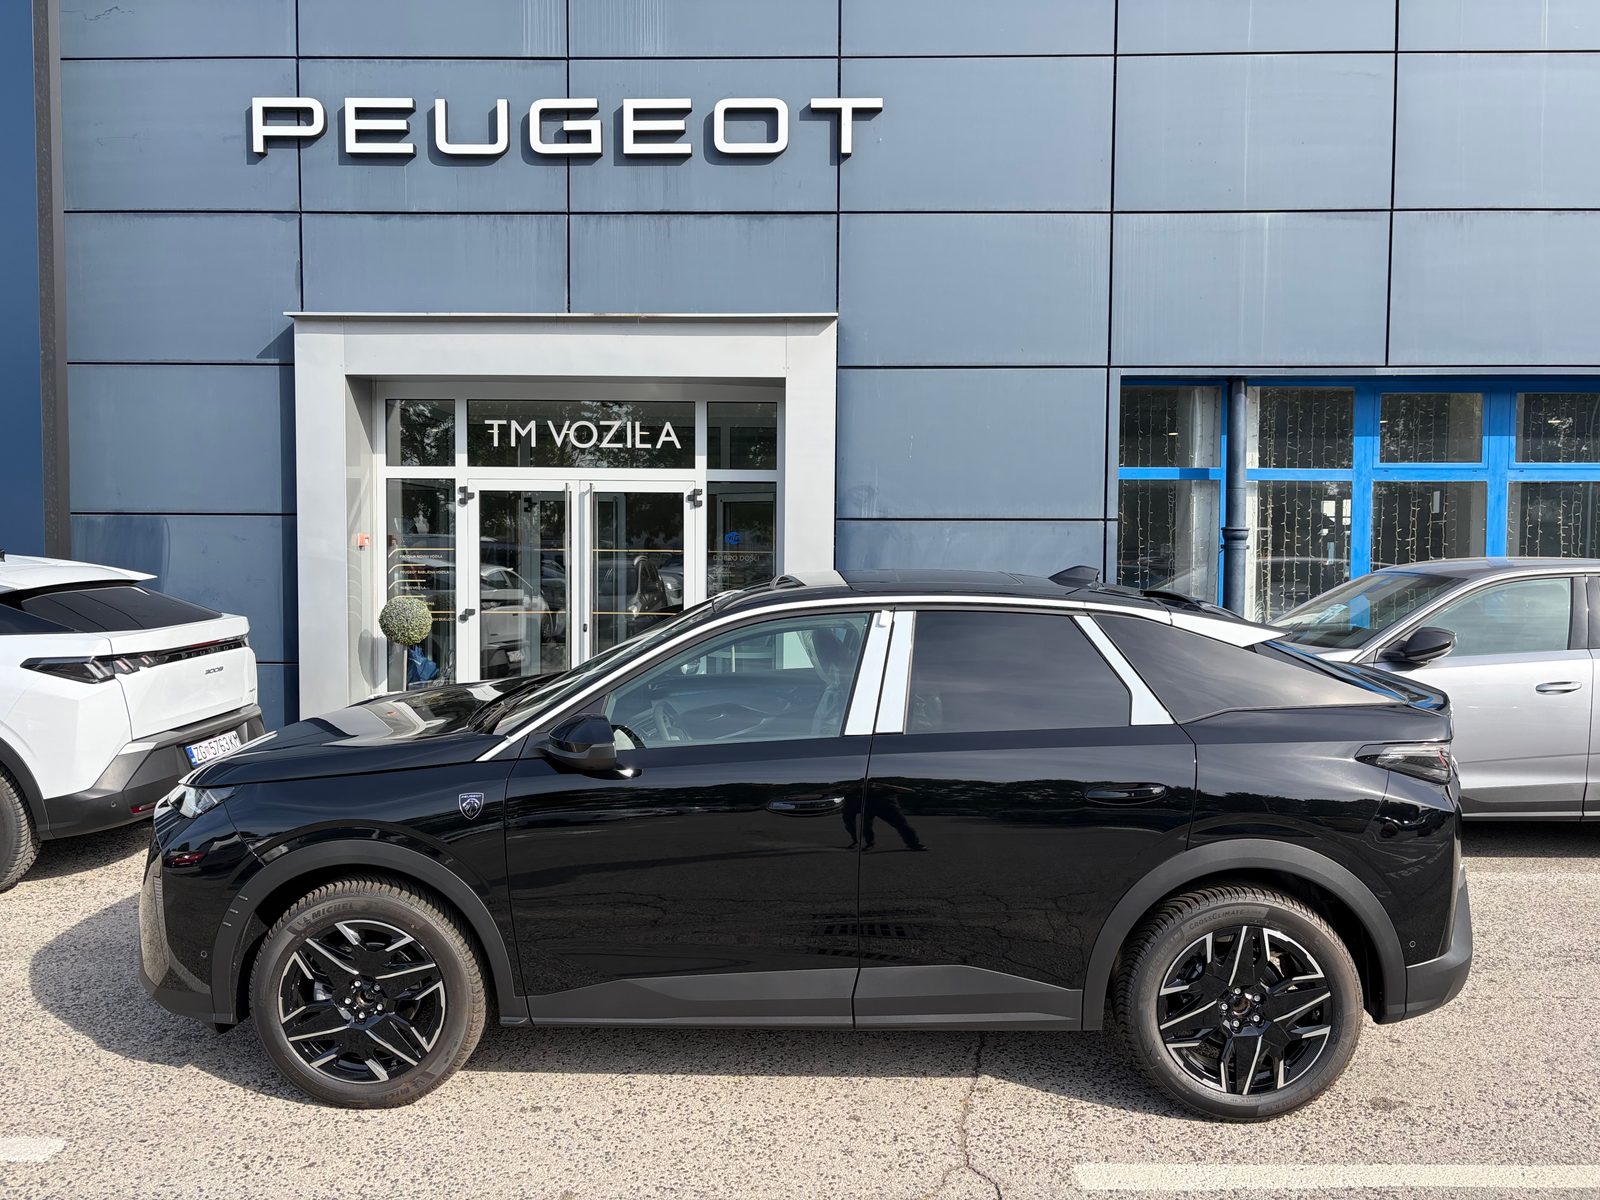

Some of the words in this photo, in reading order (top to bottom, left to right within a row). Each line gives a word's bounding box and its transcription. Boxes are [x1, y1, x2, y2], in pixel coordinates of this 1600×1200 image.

[250, 97, 884, 157] PEUGEOT
[484, 419, 537, 448] TM
[547, 420, 682, 449] VOZILA
[193, 745, 207, 762] ZG
